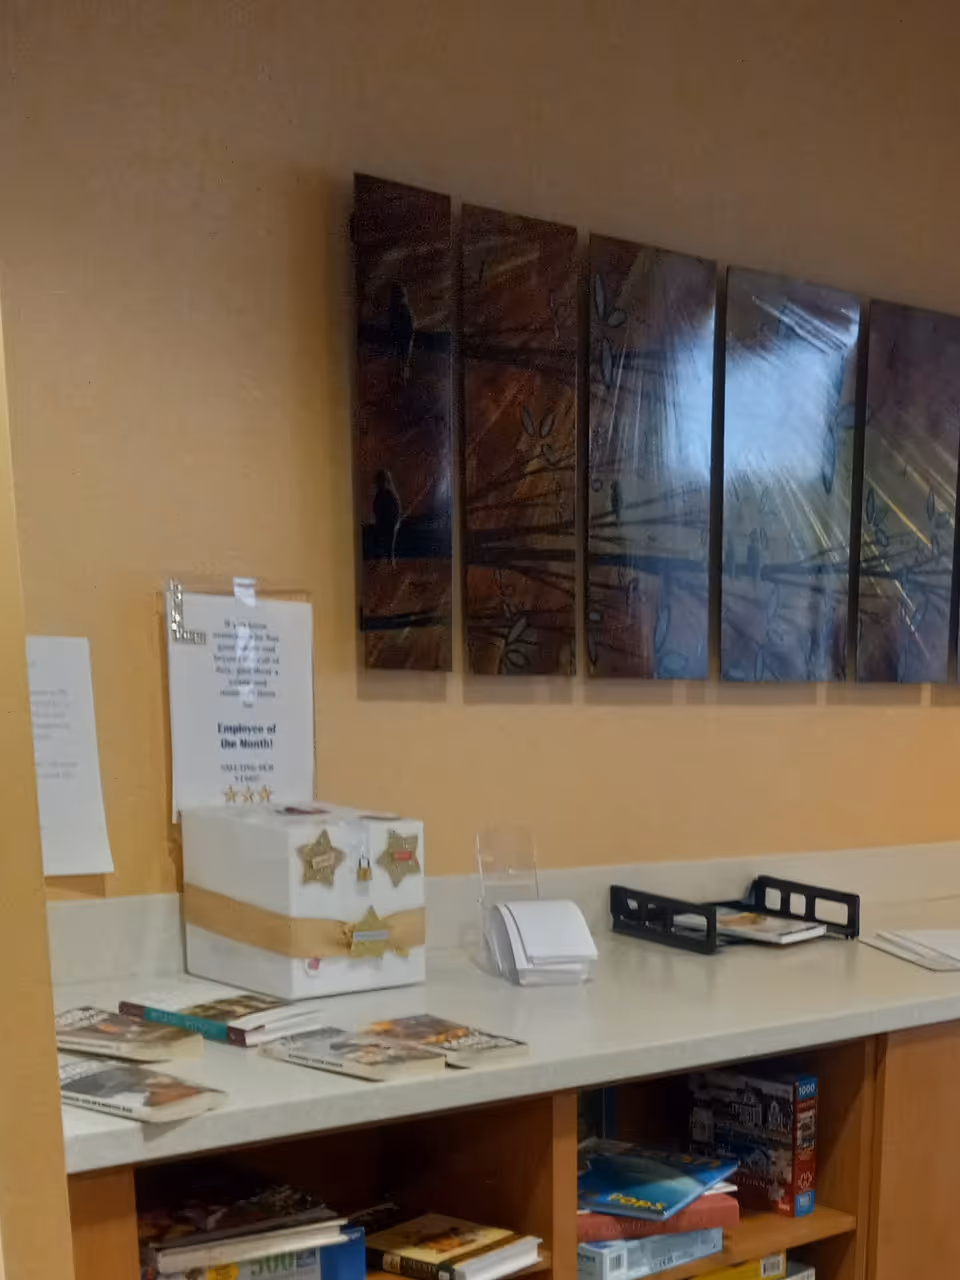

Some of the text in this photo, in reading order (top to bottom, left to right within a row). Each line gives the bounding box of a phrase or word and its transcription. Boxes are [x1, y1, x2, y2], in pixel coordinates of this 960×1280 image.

[217, 722, 276, 735] Employee of
[220, 738, 273, 749] the Month!
[799, 1083, 816, 1096] 1000
